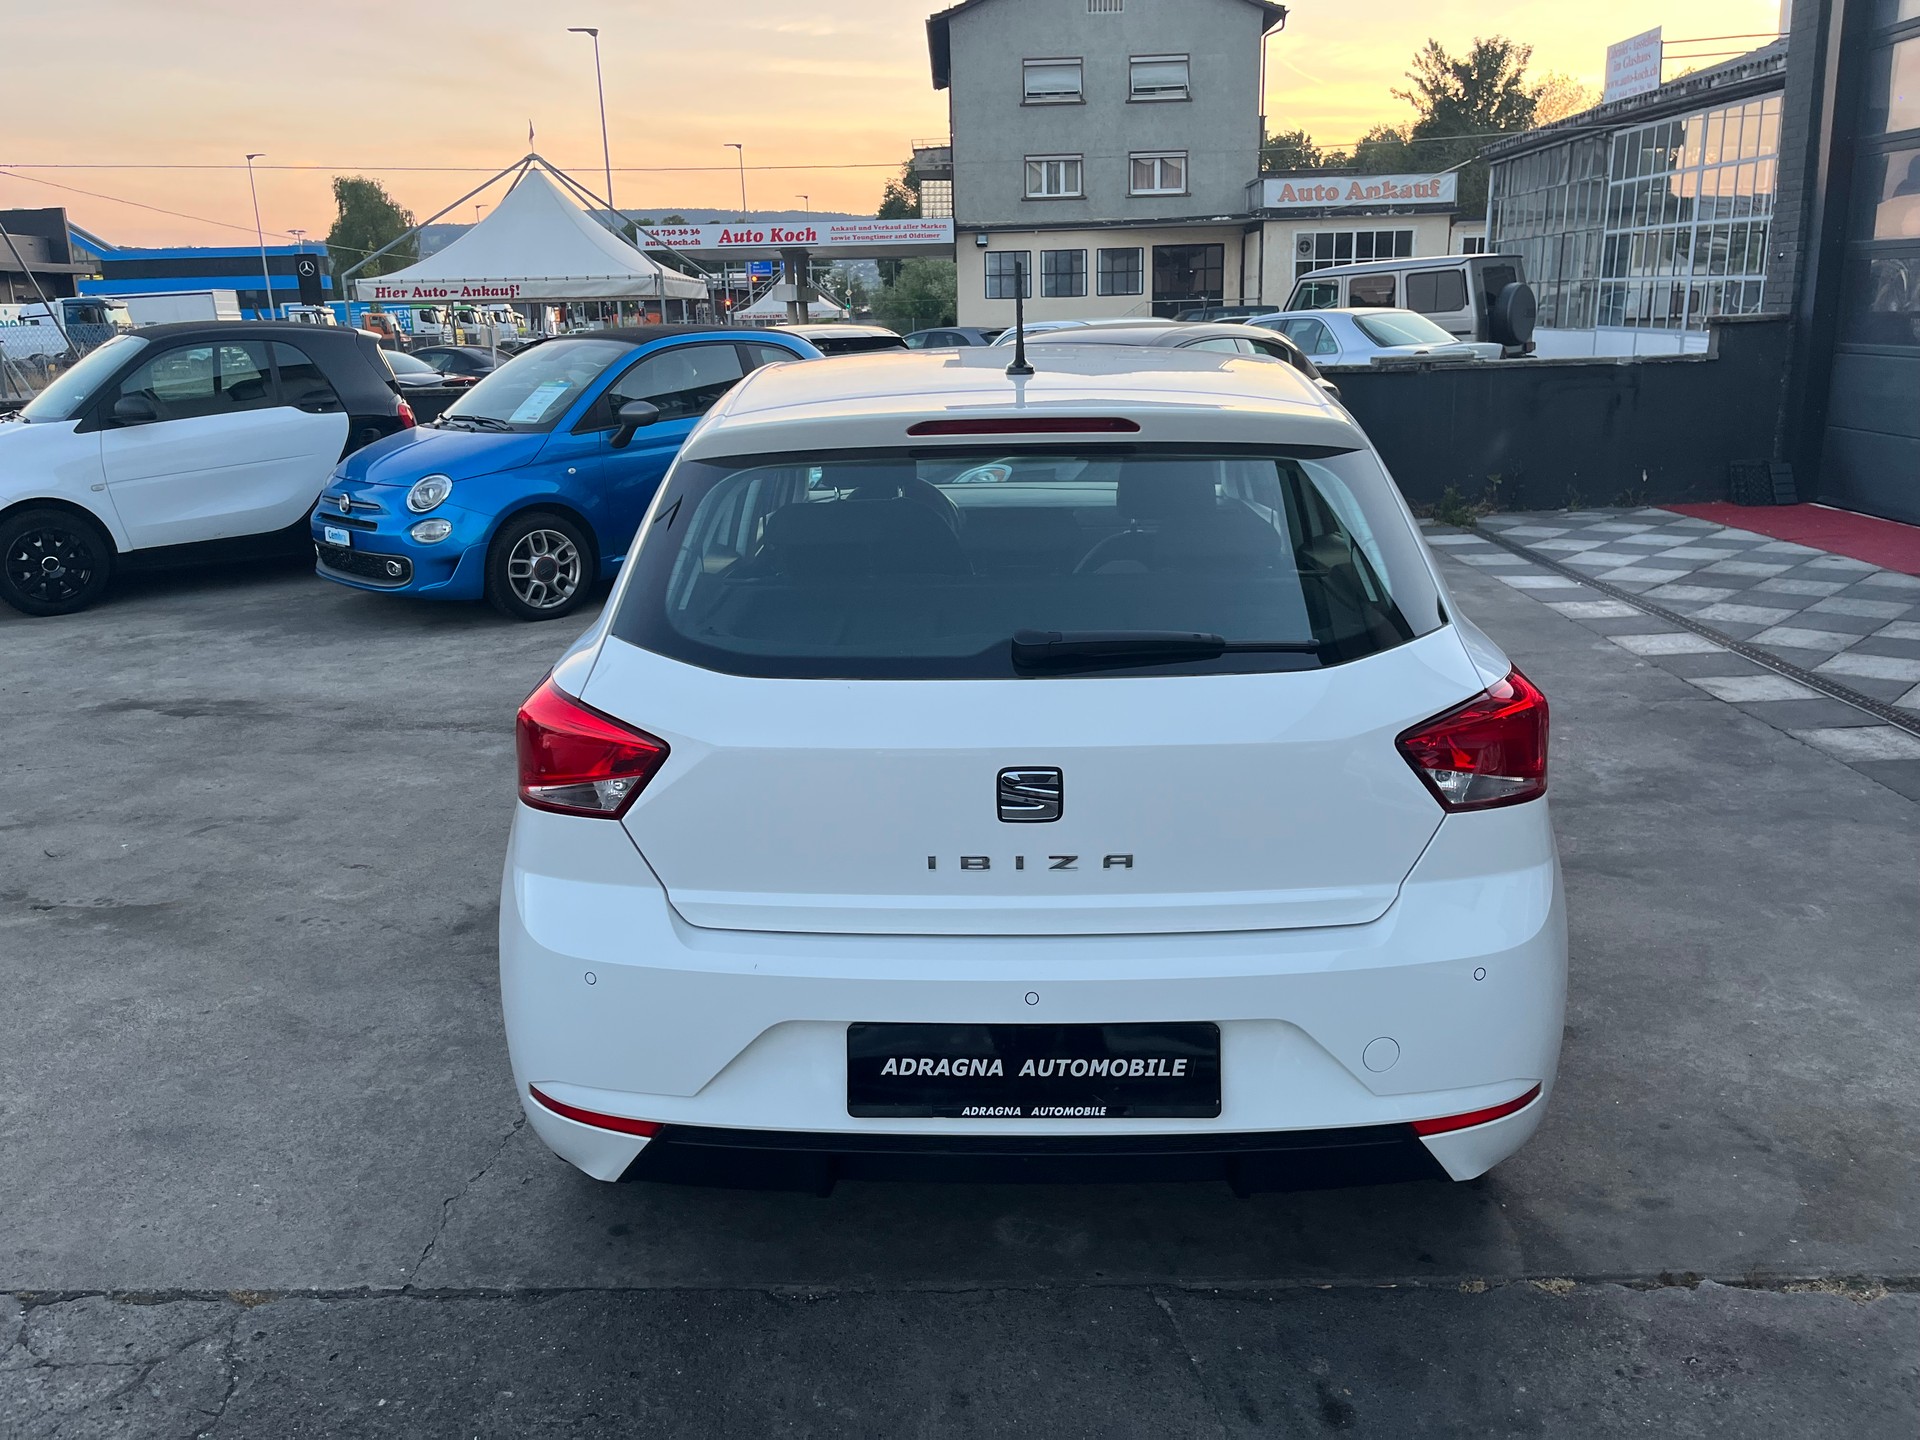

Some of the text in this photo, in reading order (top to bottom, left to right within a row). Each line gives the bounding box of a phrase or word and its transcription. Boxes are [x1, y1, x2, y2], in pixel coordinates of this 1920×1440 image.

[1277, 179, 1441, 202] Auto Ankauf
[645, 228, 700, 237] 44 730 36 36
[718, 227, 817, 244] Auto Koch
[830, 233, 851, 241] sowie
[852, 233, 893, 242] Youngtimer
[645, 238, 701, 246] aut-koch.ch
[375, 287, 408, 299] Hier
[928, 854, 1134, 870] IBIZA
[881, 1058, 1188, 1077] ADRAGNA AUTOMOBILE
[961, 1106, 1107, 1116] ADRAGNA AUTOMOBILE
